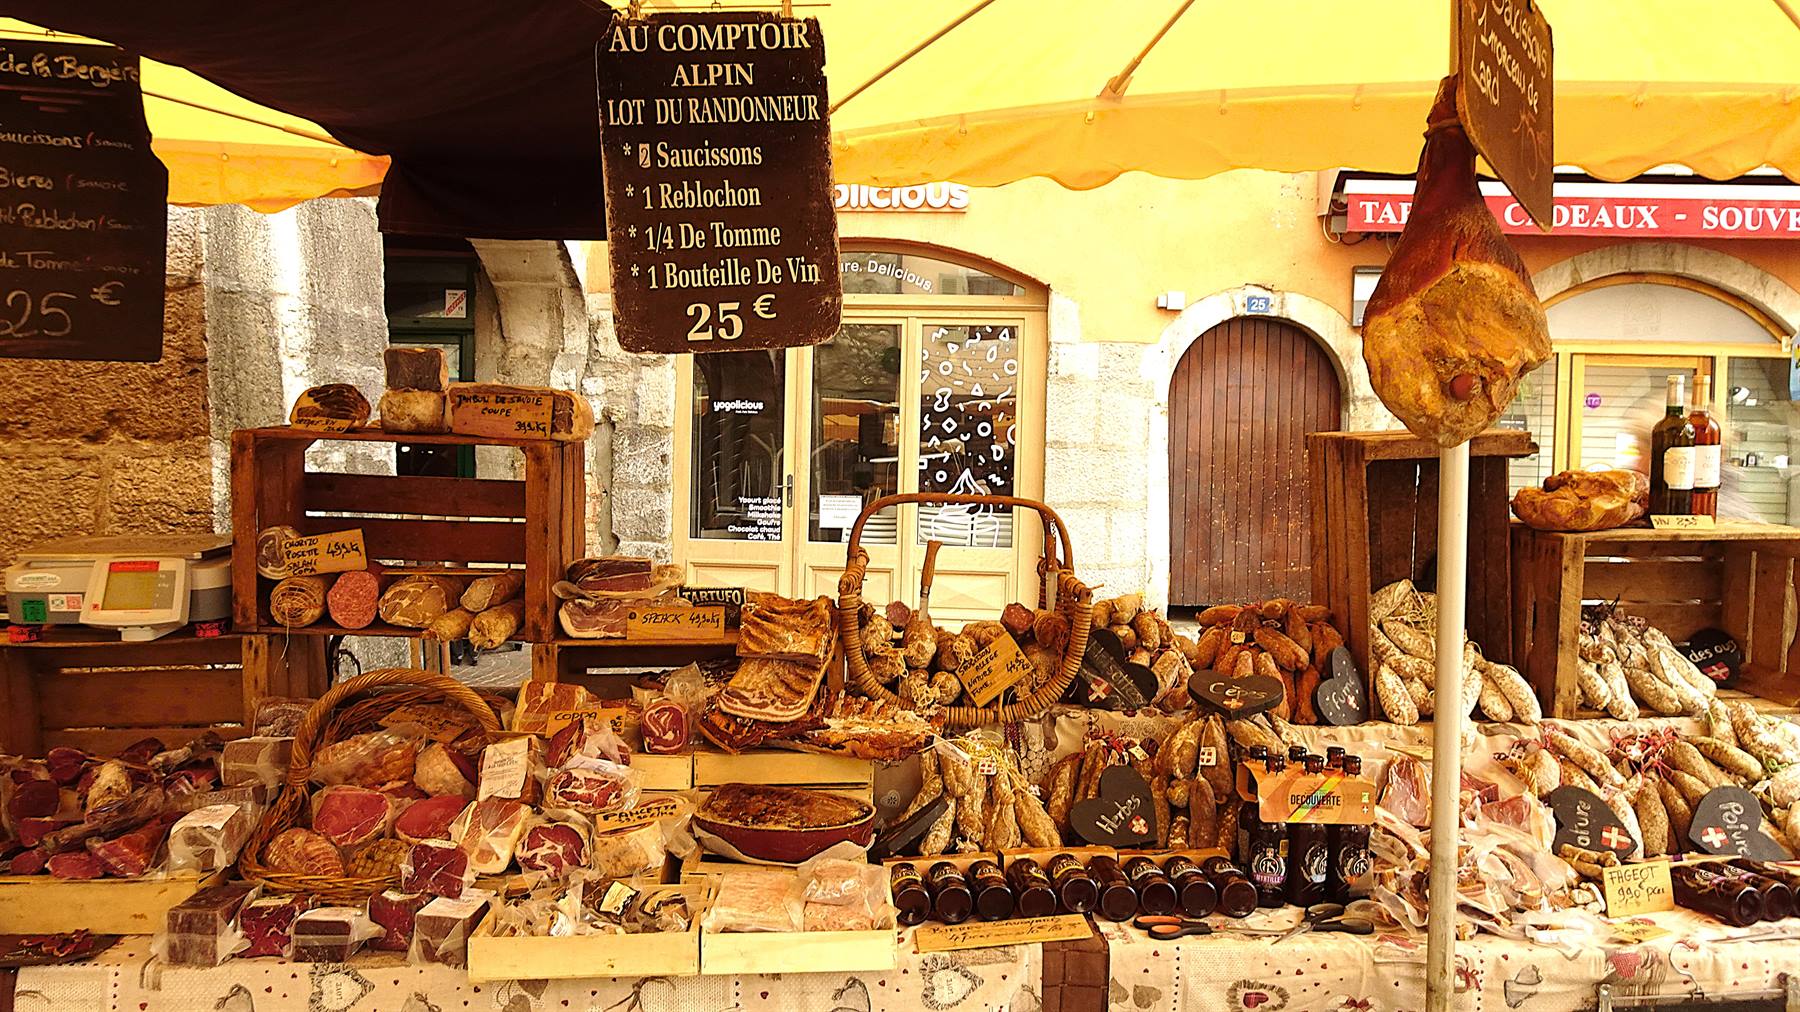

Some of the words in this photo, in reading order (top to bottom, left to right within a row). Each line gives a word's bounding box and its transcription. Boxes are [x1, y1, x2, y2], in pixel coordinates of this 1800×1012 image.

[609, 25, 649, 52] AU
[658, 22, 811, 51] COMPTOIR
[671, 62, 754, 87] ALPIN
[1528, 76, 1539, 114] de
[608, 98, 645, 126] LOT
[656, 97, 683, 124] DU
[688, 94, 821, 124] RANDONNEUR
[639, 143, 650, 168] 2
[657, 140, 762, 168] Saucissons
[643, 186, 653, 209] 1
[659, 180, 761, 209] Reblochon
[1504, 202, 1659, 229] CDEAUX
[645, 222, 674, 252] 1/4
[679, 223, 705, 249] De
[711, 222, 781, 248] Tomme
[648, 265, 658, 289] 1
[664, 257, 751, 288] Bouteille
[756, 259, 782, 285] De
[786, 256, 821, 284] Vin
[0, 290, 78, 337] 25
[90, 281, 125, 305] €
[686, 302, 743, 341] 25
[753, 294, 777, 319] €
[1250, 298, 1267, 311] 25
[713, 400, 764, 412] yogolicious
[682, 589, 741, 605] TARTUFO
[1689, 649, 1713, 663] des
[1095, 794, 1141, 835] Herbes
